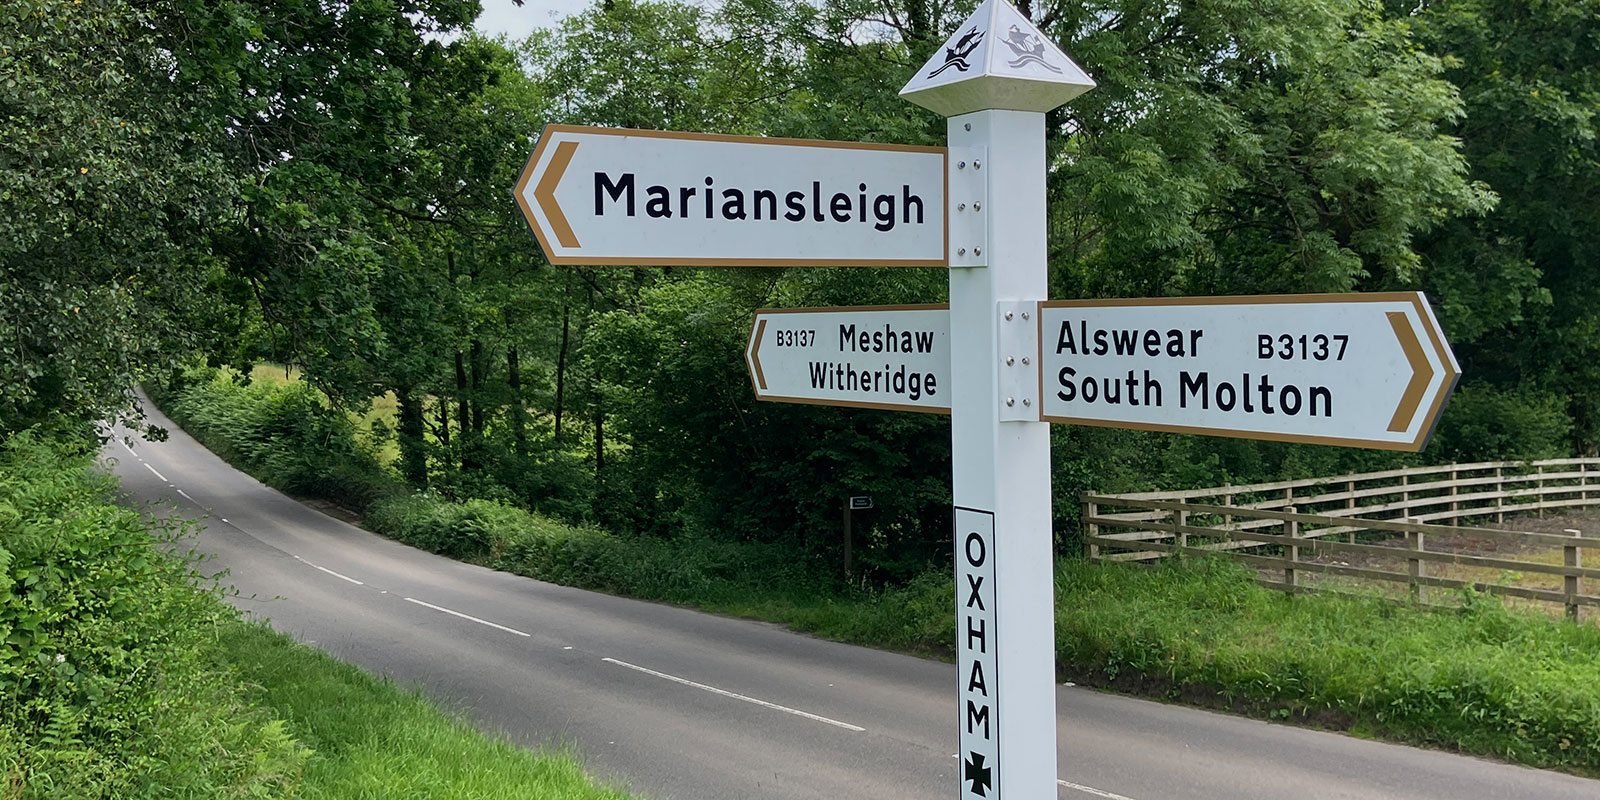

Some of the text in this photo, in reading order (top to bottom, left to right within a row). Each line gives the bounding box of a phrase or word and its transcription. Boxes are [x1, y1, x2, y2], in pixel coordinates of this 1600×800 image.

[594, 172, 924, 232] Mariansleigh
[776, 324, 934, 353] B3137 Meshaw
[1056, 321, 1349, 360] Alswear B3137
[809, 362, 937, 401] Witheridge
[1056, 367, 1332, 417] South Molton
[965, 532, 990, 740] OXHAM
